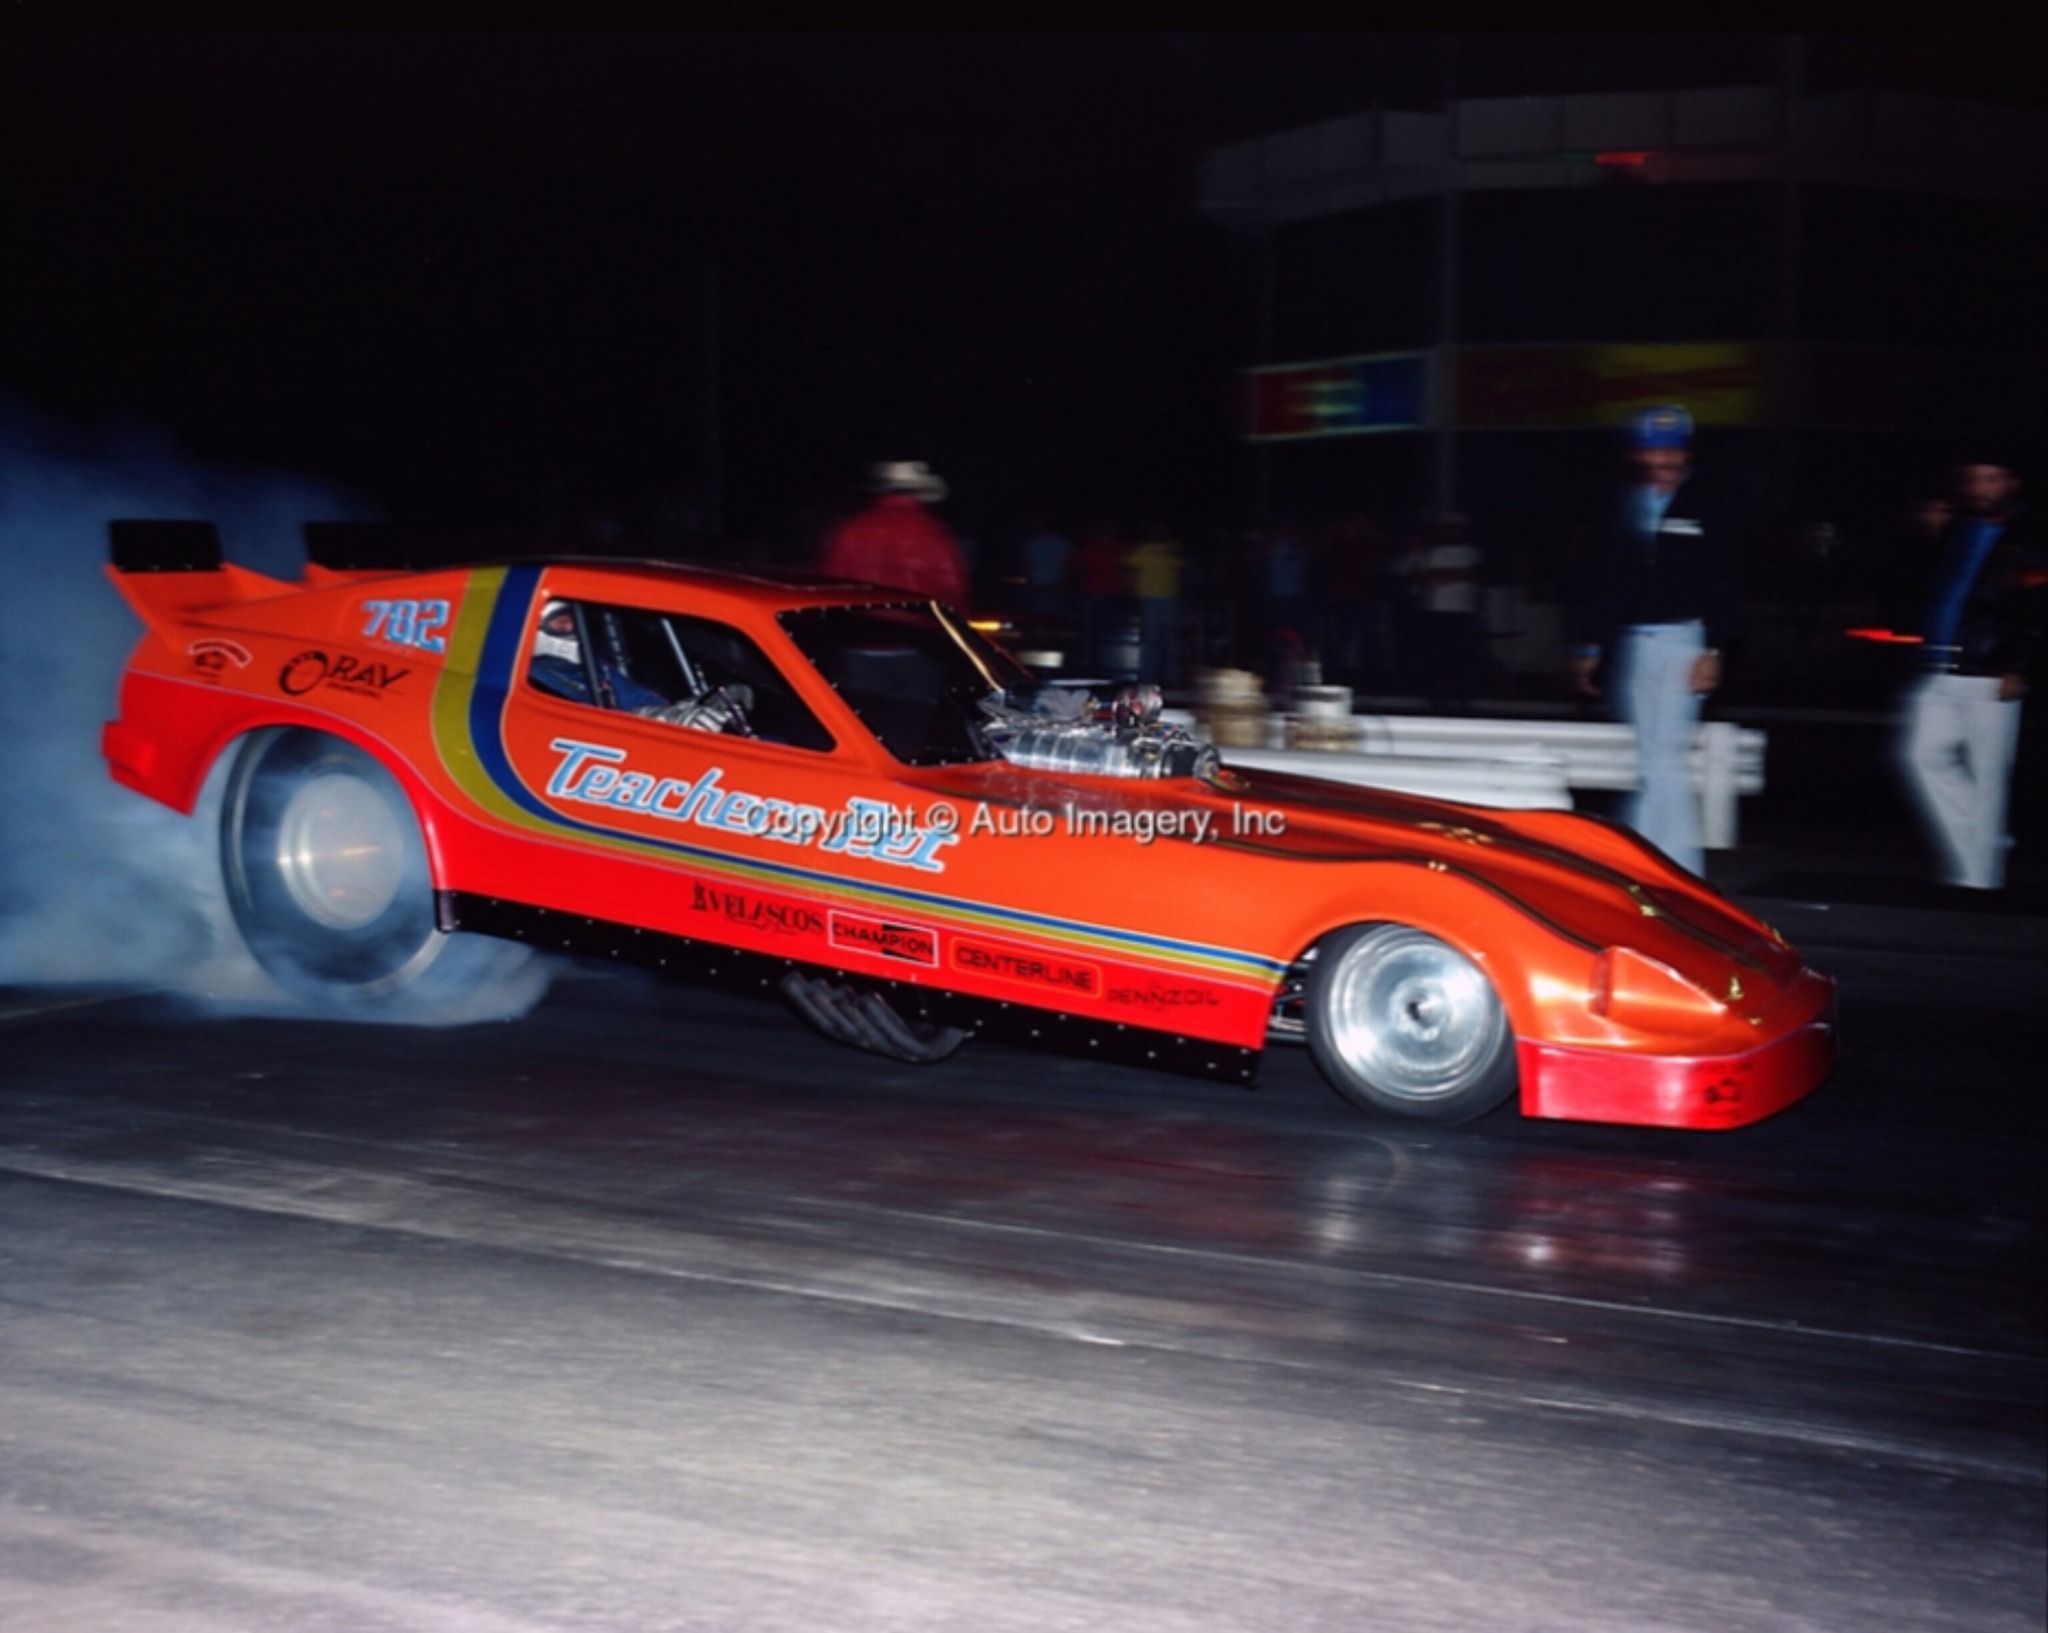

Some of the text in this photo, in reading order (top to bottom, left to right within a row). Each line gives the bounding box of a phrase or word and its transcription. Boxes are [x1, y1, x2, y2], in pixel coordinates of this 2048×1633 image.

[361, 599, 449, 653] 782
[831, 922, 935, 956] CHAMPION
[955, 946, 1092, 990] CENTERLINE
[1105, 987, 1220, 1008] PENNZOIL
